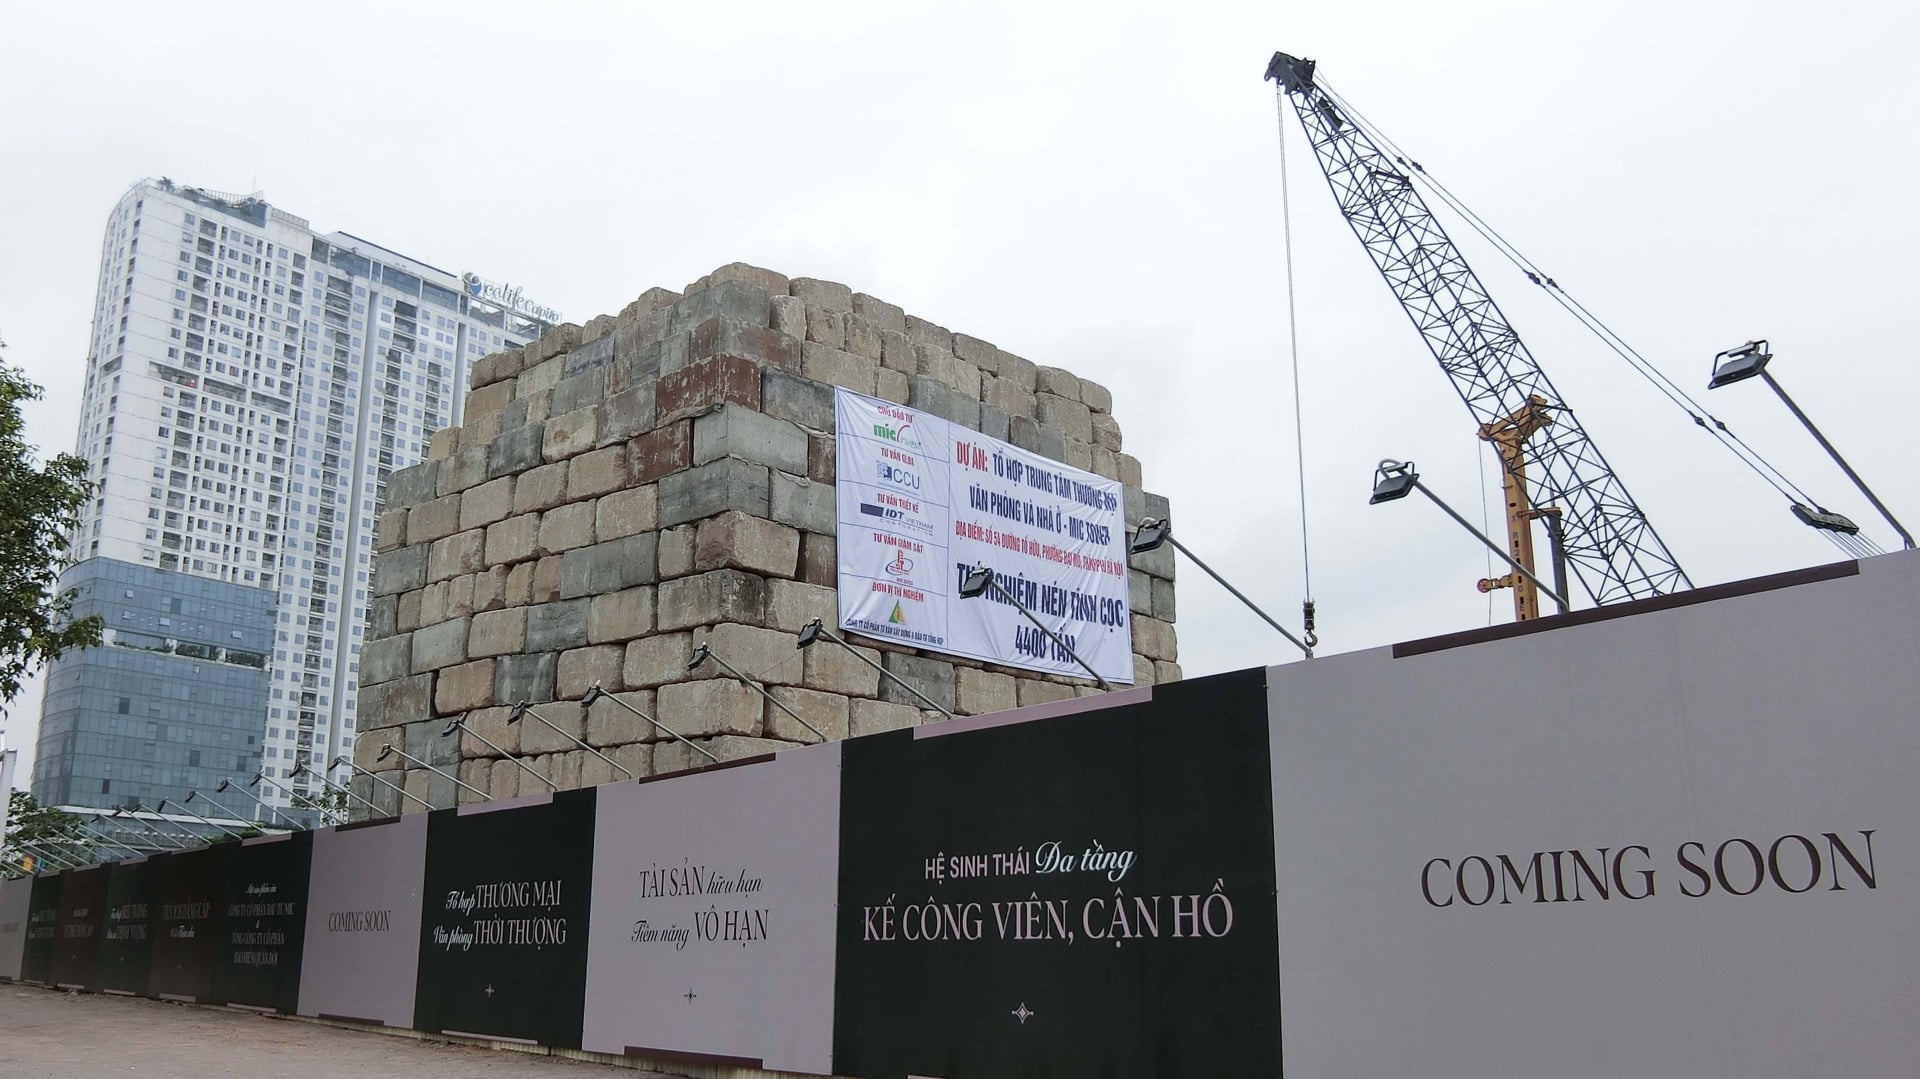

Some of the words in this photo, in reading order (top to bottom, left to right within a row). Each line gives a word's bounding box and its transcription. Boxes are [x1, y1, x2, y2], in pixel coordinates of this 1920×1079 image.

[873, 423, 896, 440] mic
[893, 468, 920, 490] CCU
[957, 440, 970, 471] DỰ
[972, 441, 988, 472] ÁN:
[992, 447, 1004, 478] TỔ
[1005, 458, 1023, 487] HỢP
[1025, 464, 1052, 494] TRUNG
[1053, 472, 1072, 500] TÂM
[1072, 480, 1102, 510] THƯƠNG
[885, 508, 904, 520] IDT
[905, 516, 934, 530] VIETNAM
[969, 482, 988, 512] VĂN
[990, 490, 1021, 522] PHÒNG
[1023, 498, 1035, 526] VÀ
[1036, 505, 1054, 532] NHÀ
[1055, 504, 1062, 534] Ở
[1069, 516, 1084, 541] MIC
[985, 524, 993, 544] SỐ
[993, 531, 1000, 547] 54
[872, 582, 886, 593] ĐƠN
[1041, 581, 1067, 618] NÉN
[1100, 597, 1124, 633] CỌC
[1015, 625, 1046, 659] 4400
[1050, 623, 1075, 664] TẤN
[639, 862, 666, 898] TÀI
[669, 856, 705, 897] SẢN
[706, 871, 734, 895] hữu
[735, 868, 763, 898] hạn
[925, 850, 945, 885] HỆ
[950, 853, 988, 879] SINH
[992, 846, 1030, 876] THÁI
[1035, 841, 1077, 873] Đa
[1080, 838, 1137, 882] tầng
[1421, 845, 1656, 907] COMING
[1676, 829, 1878, 898] SOON
[457, 891, 475, 916] hợp
[475, 881, 530, 908] THƯƠNG
[532, 880, 562, 911] MẠI
[863, 893, 896, 941] KẾ
[903, 895, 983, 941] CÔNG
[991, 891, 1074, 946] VIÊN,
[1082, 886, 1161, 948] CẬN
[1171, 878, 1233, 938] HỒ
[328, 911, 363, 932] COMING
[364, 910, 391, 932] SOON
[433, 925, 449, 944] Văn
[446, 925, 474, 951] phòng
[473, 913, 505, 944] THỜI
[507, 916, 567, 950] THƯỢNG
[660, 925, 690, 951] năng
[694, 904, 719, 941] VÔ
[723, 909, 769, 948] HẠN
